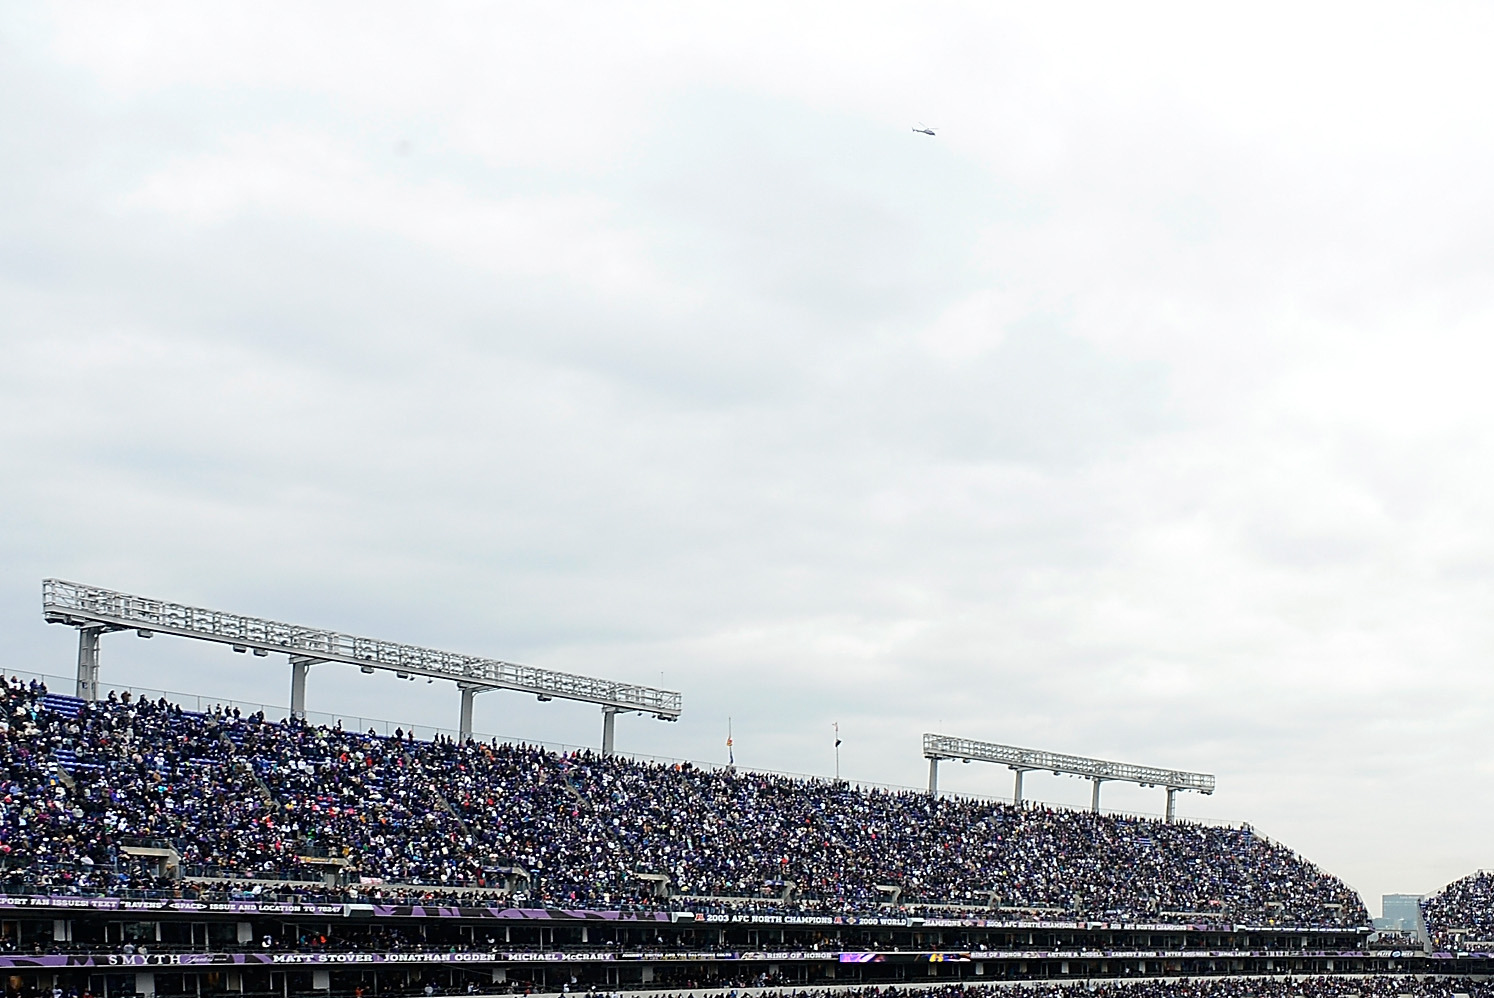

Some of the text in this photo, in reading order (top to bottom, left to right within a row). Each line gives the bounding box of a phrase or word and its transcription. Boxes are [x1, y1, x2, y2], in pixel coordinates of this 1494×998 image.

[30, 898, 50, 906] FAN
[52, 899, 89, 907] ISSUES!
[91, 900, 117, 908] TEXT
[169, 902, 208, 910] <SPACE>
[209, 903, 236, 911] ISSUE
[240, 903, 257, 911] AND
[259, 904, 301, 912] LOCATION
[707, 914, 907, 926] 2003 AFC NORTH CHAMPIONS 2000 WORLD
[108, 954, 181, 965] SMYTH
[273, 954, 373, 963] MATT STOVER
[384, 953, 496, 962] JONATHAN OGDEN
[508, 953, 612, 961] MICHAEL McCRARY
[803, 952, 832, 960] HONOR
